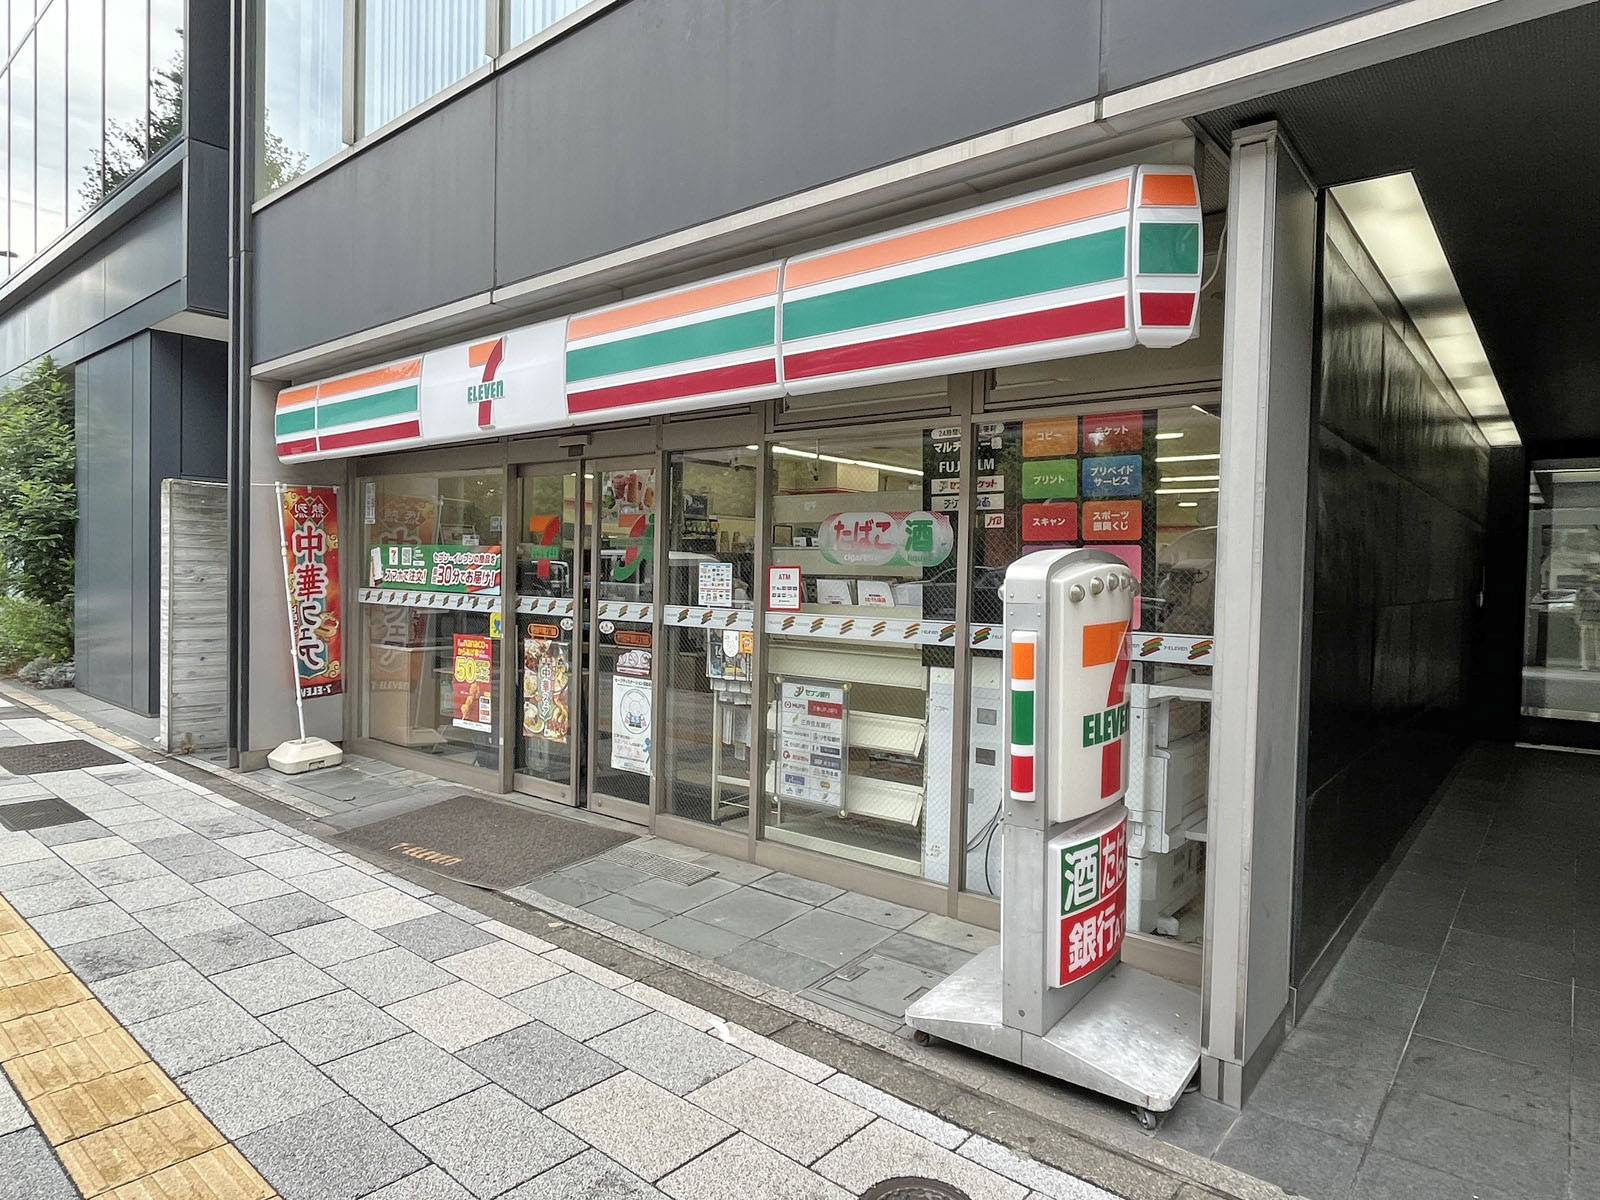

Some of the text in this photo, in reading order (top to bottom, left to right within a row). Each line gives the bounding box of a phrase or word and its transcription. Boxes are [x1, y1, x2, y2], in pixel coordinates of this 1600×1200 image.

[1036, 431, 1064, 441] コピー
[1090, 465, 1134, 476] プリペイド
[1033, 475, 1065, 485] プリント
[1093, 476, 1130, 487] サービス
[987, 516, 1003, 527] JTB
[1093, 511, 1130, 521] スポーツ
[1032, 518, 1066, 527] スキャン
[834, 519, 934, 552] たばこ 酒
[455, 657, 475, 683] 50
[1064, 844, 1099, 911] 酒
